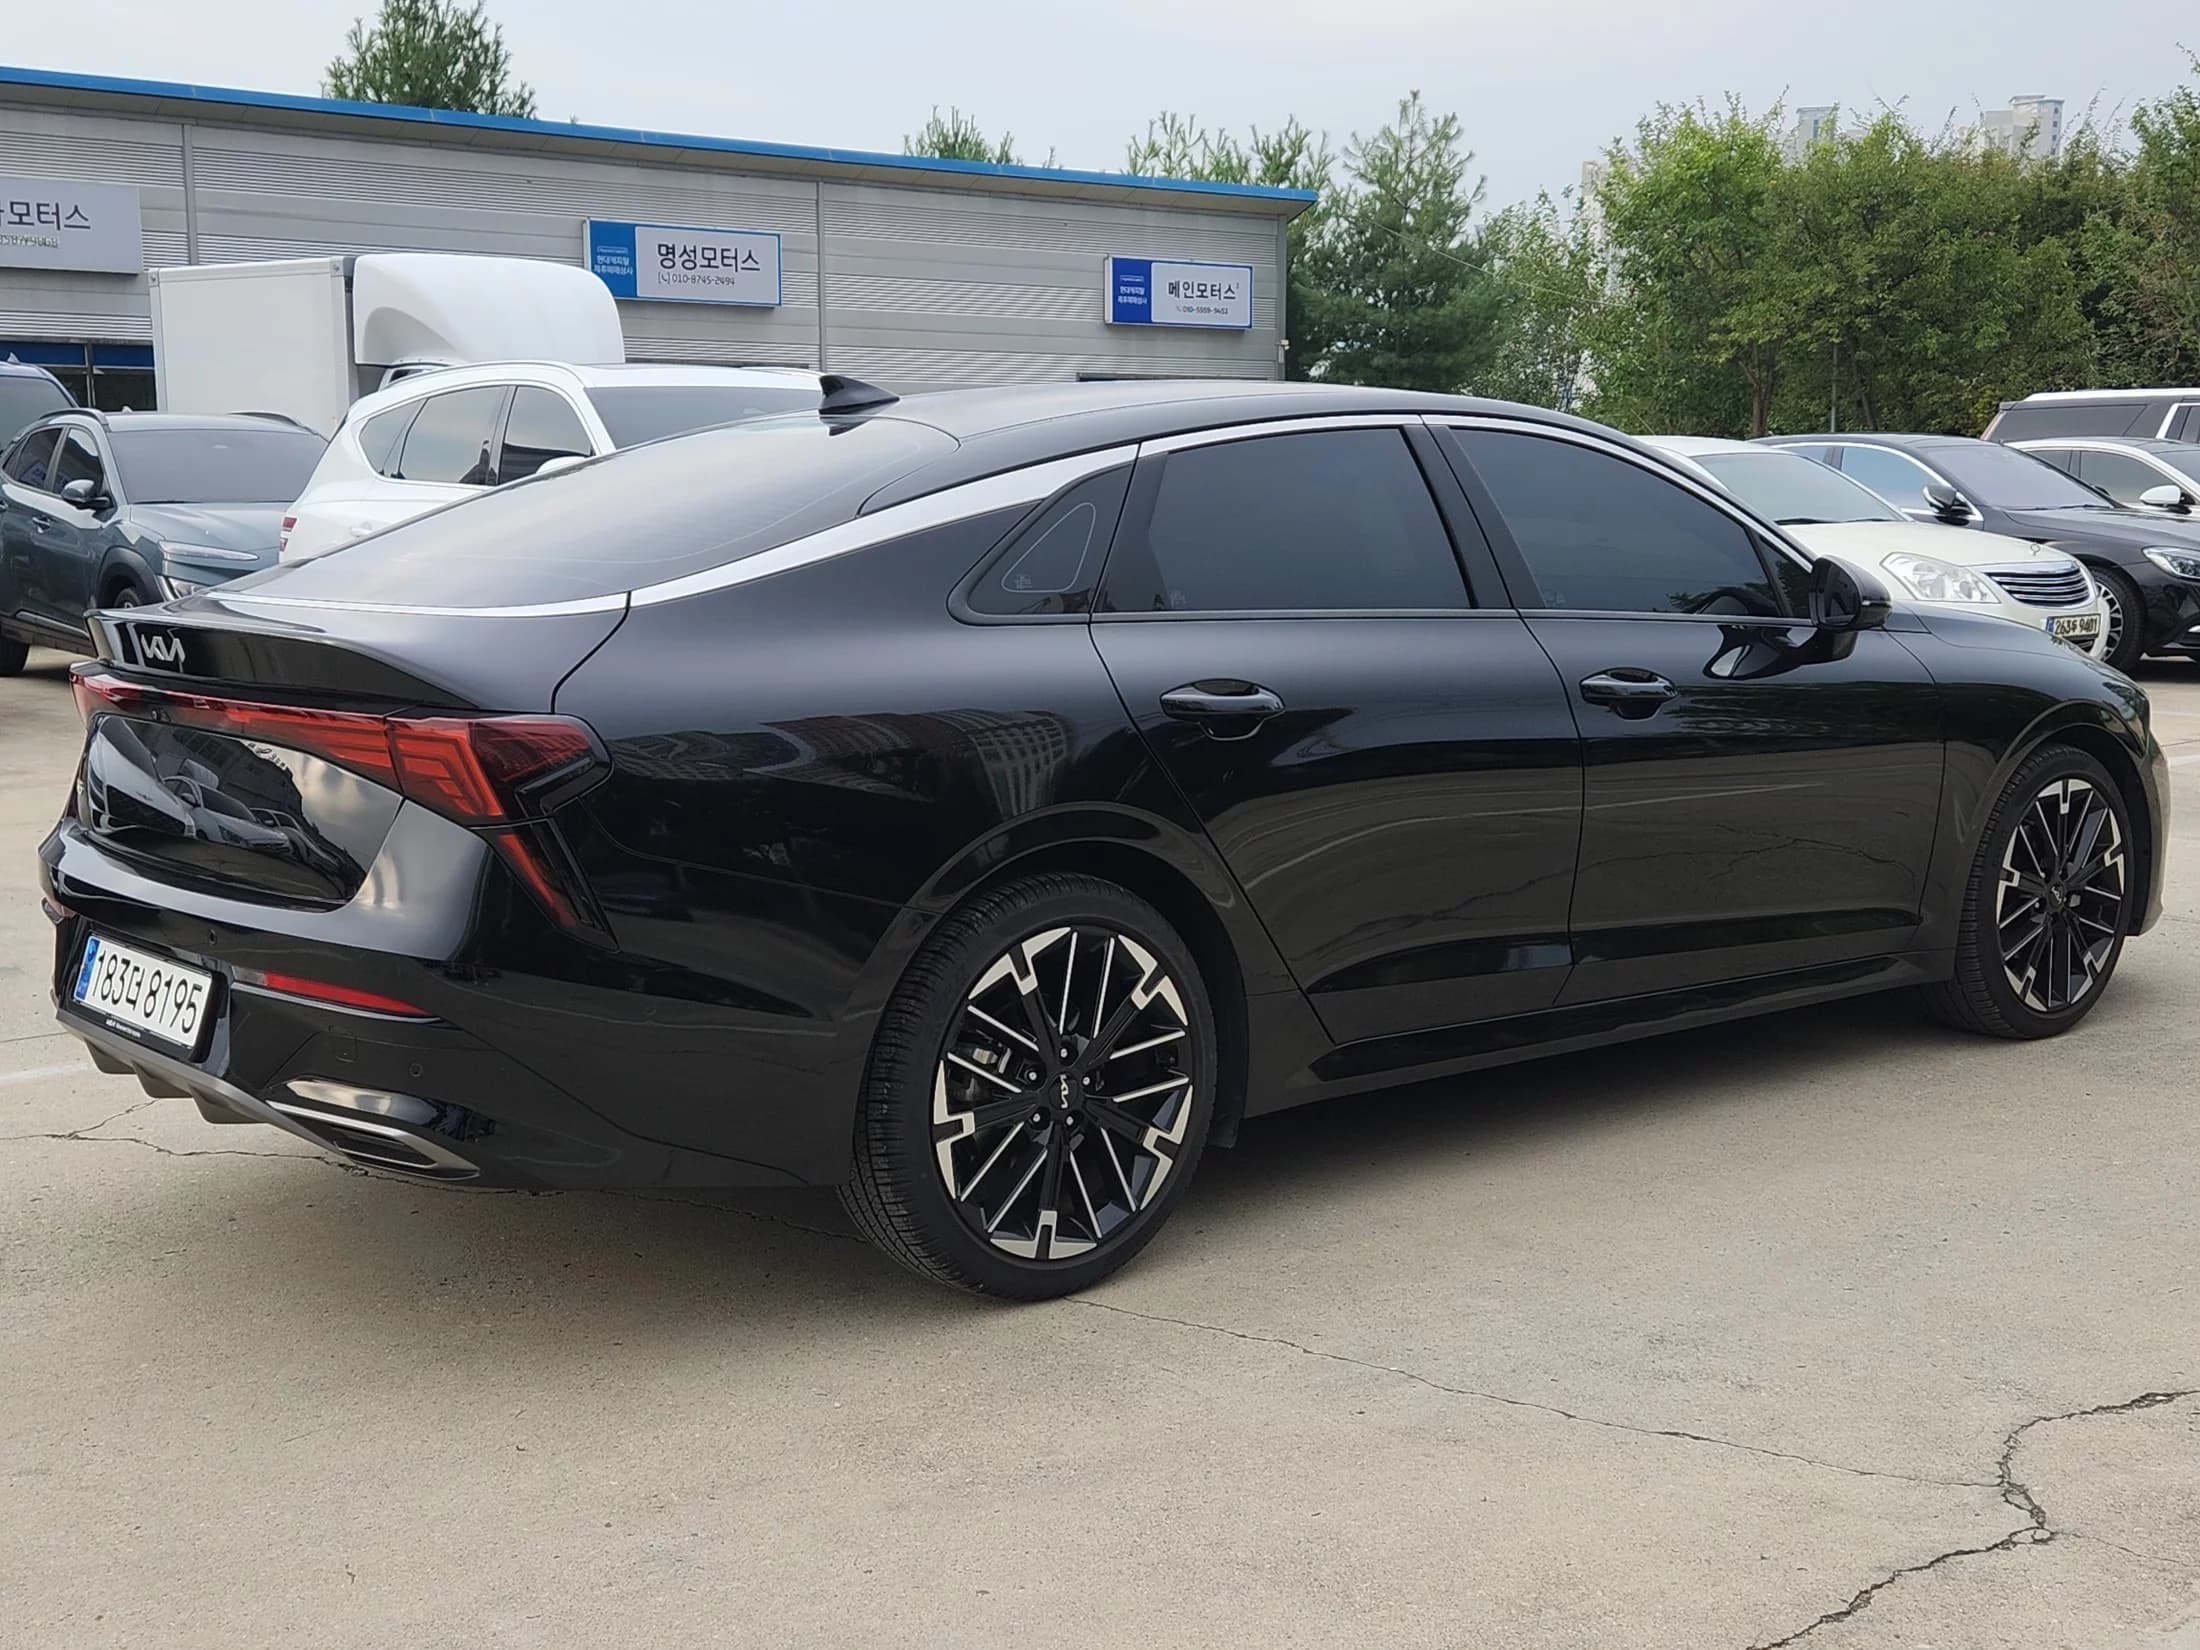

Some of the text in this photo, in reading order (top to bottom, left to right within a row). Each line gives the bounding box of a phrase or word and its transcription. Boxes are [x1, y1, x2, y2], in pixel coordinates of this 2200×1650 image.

[0, 200, 91, 231] 모터스
[657, 243, 761, 273] 명성모터스
[1168, 281, 1236, 300] 메인모터스
[143, 970, 203, 1034] 8195
